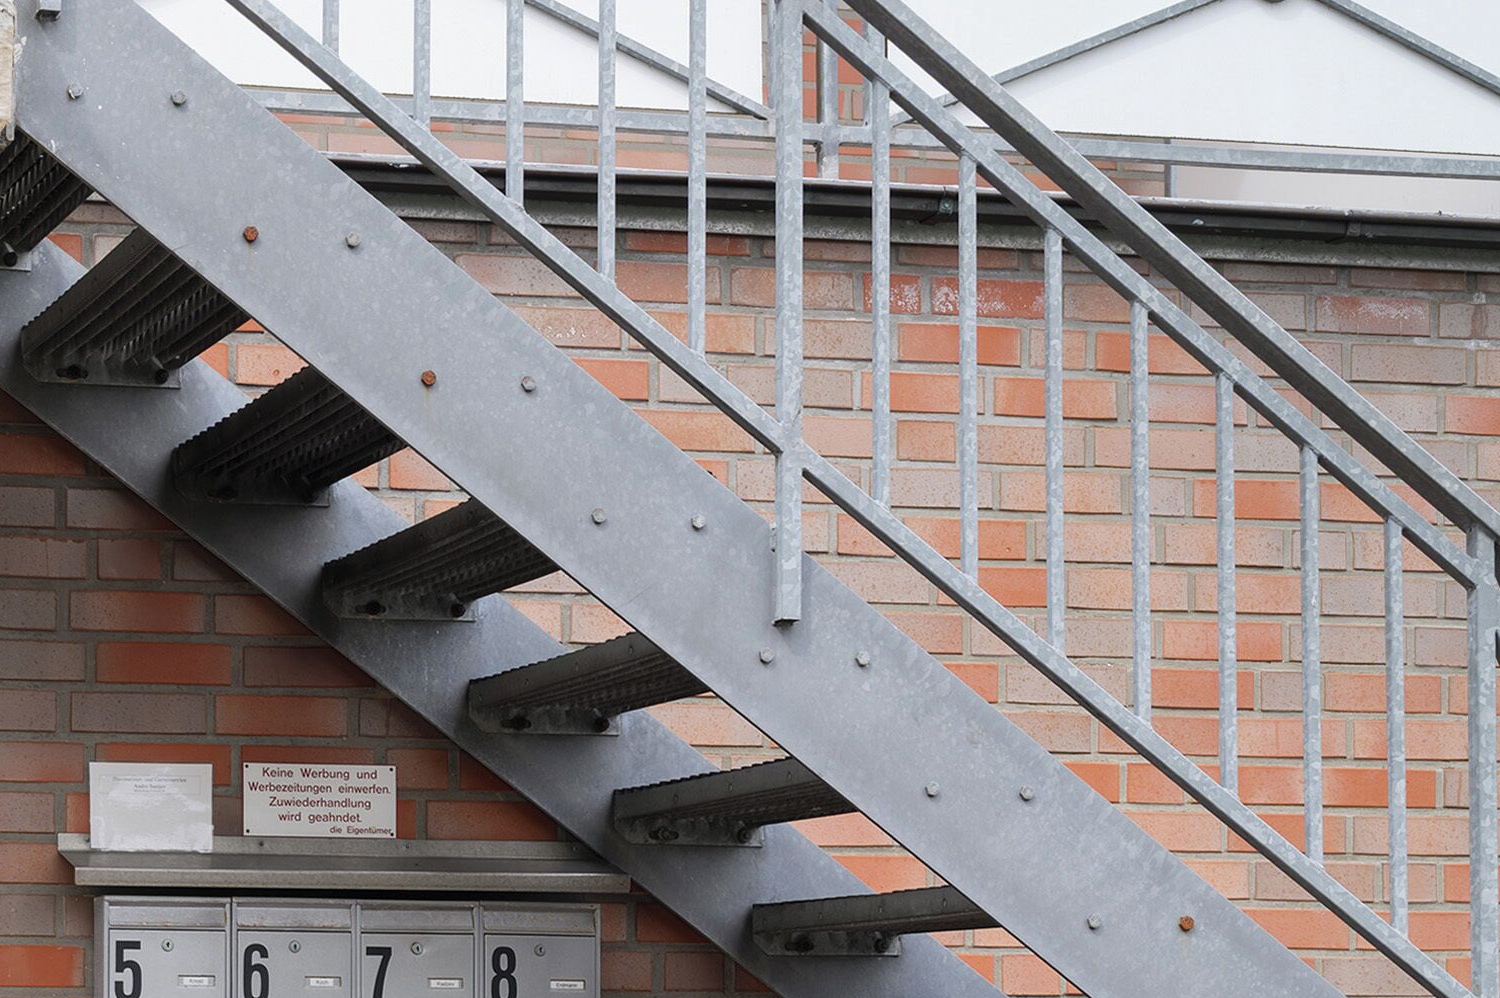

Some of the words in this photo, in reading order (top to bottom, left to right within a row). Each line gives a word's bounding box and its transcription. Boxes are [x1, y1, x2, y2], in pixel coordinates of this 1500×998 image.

[262, 767, 294, 778] Keine
[300, 768, 350, 781] Werbung
[356, 769, 378, 780] und
[248, 781, 332, 795] Werbezeitungen
[338, 783, 391, 795] einwerfen.
[269, 796, 372, 811] Zuwiederhandlung
[278, 811, 302, 822] wird
[329, 826, 342, 834] die
[346, 825, 392, 836] Eigentümer
